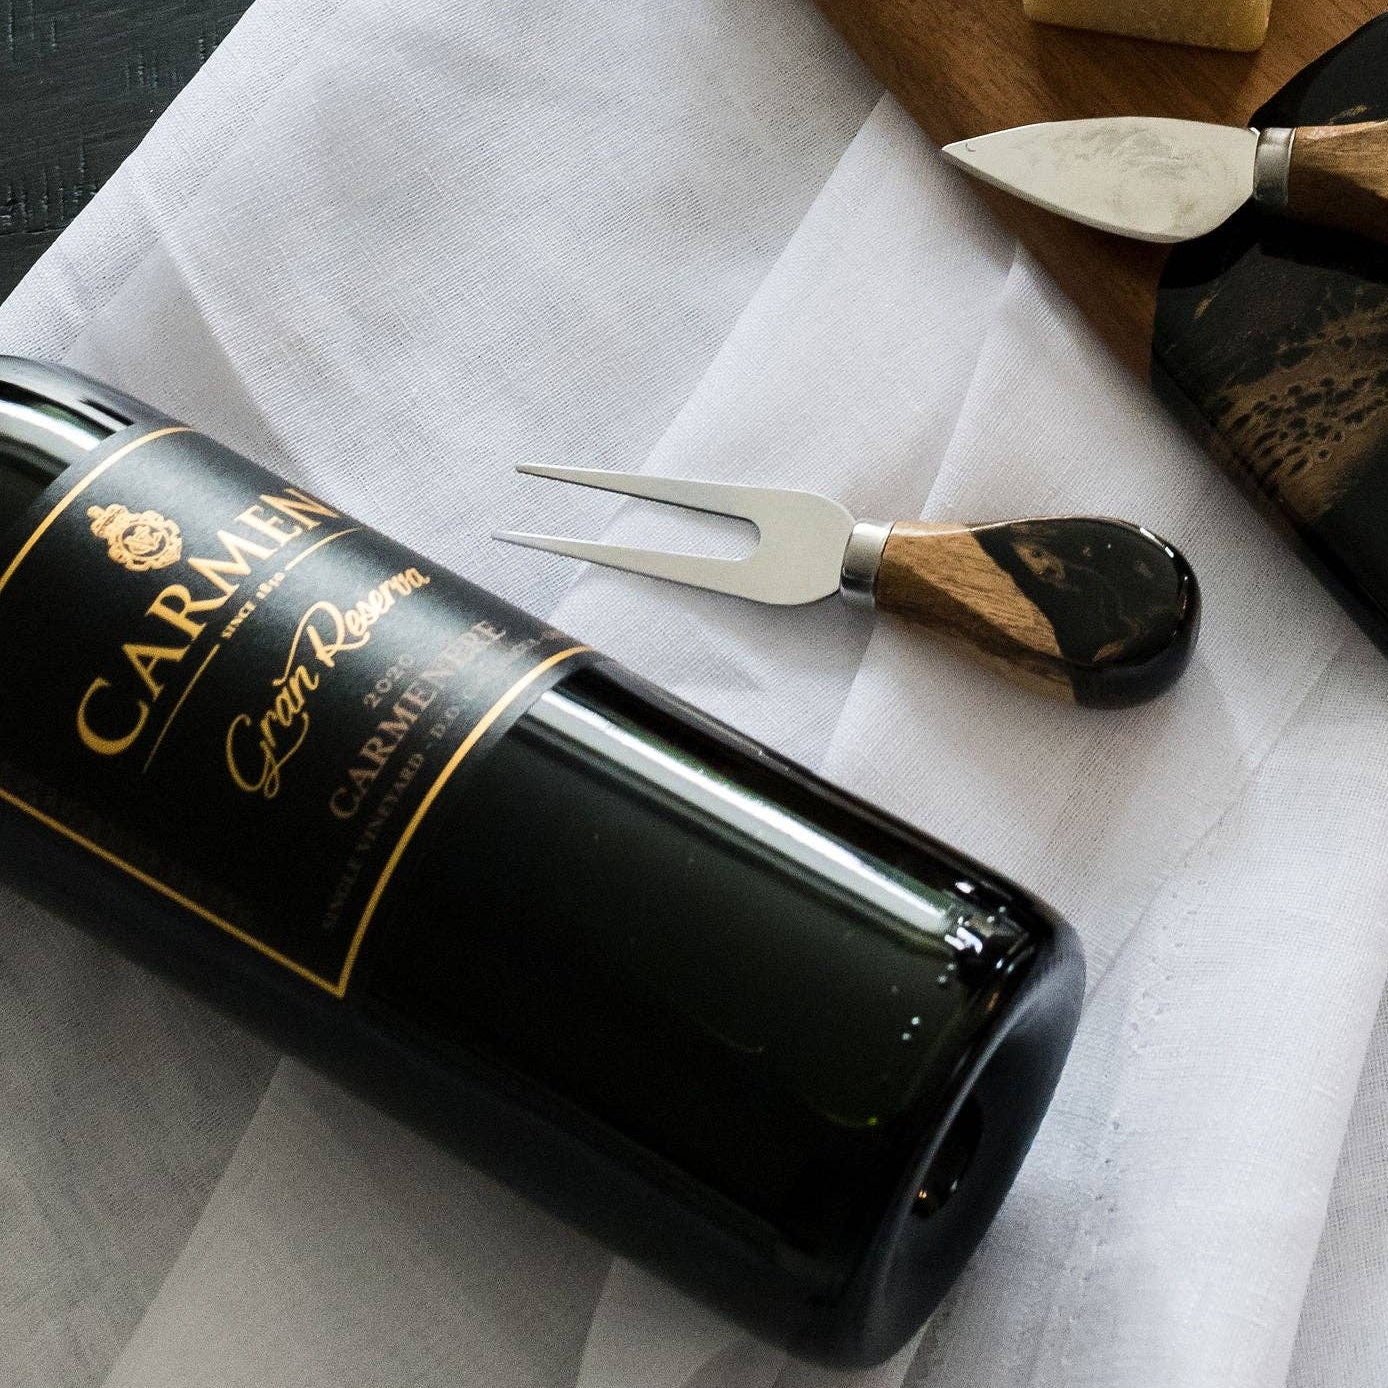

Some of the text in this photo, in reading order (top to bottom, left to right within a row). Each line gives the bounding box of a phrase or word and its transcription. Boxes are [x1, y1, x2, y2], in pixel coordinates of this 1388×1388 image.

[77, 488, 342, 755] CARMEN
[221, 600, 257, 639] SINCE
[272, 567, 431, 668] Reserva
[363, 654, 414, 709] 2020
